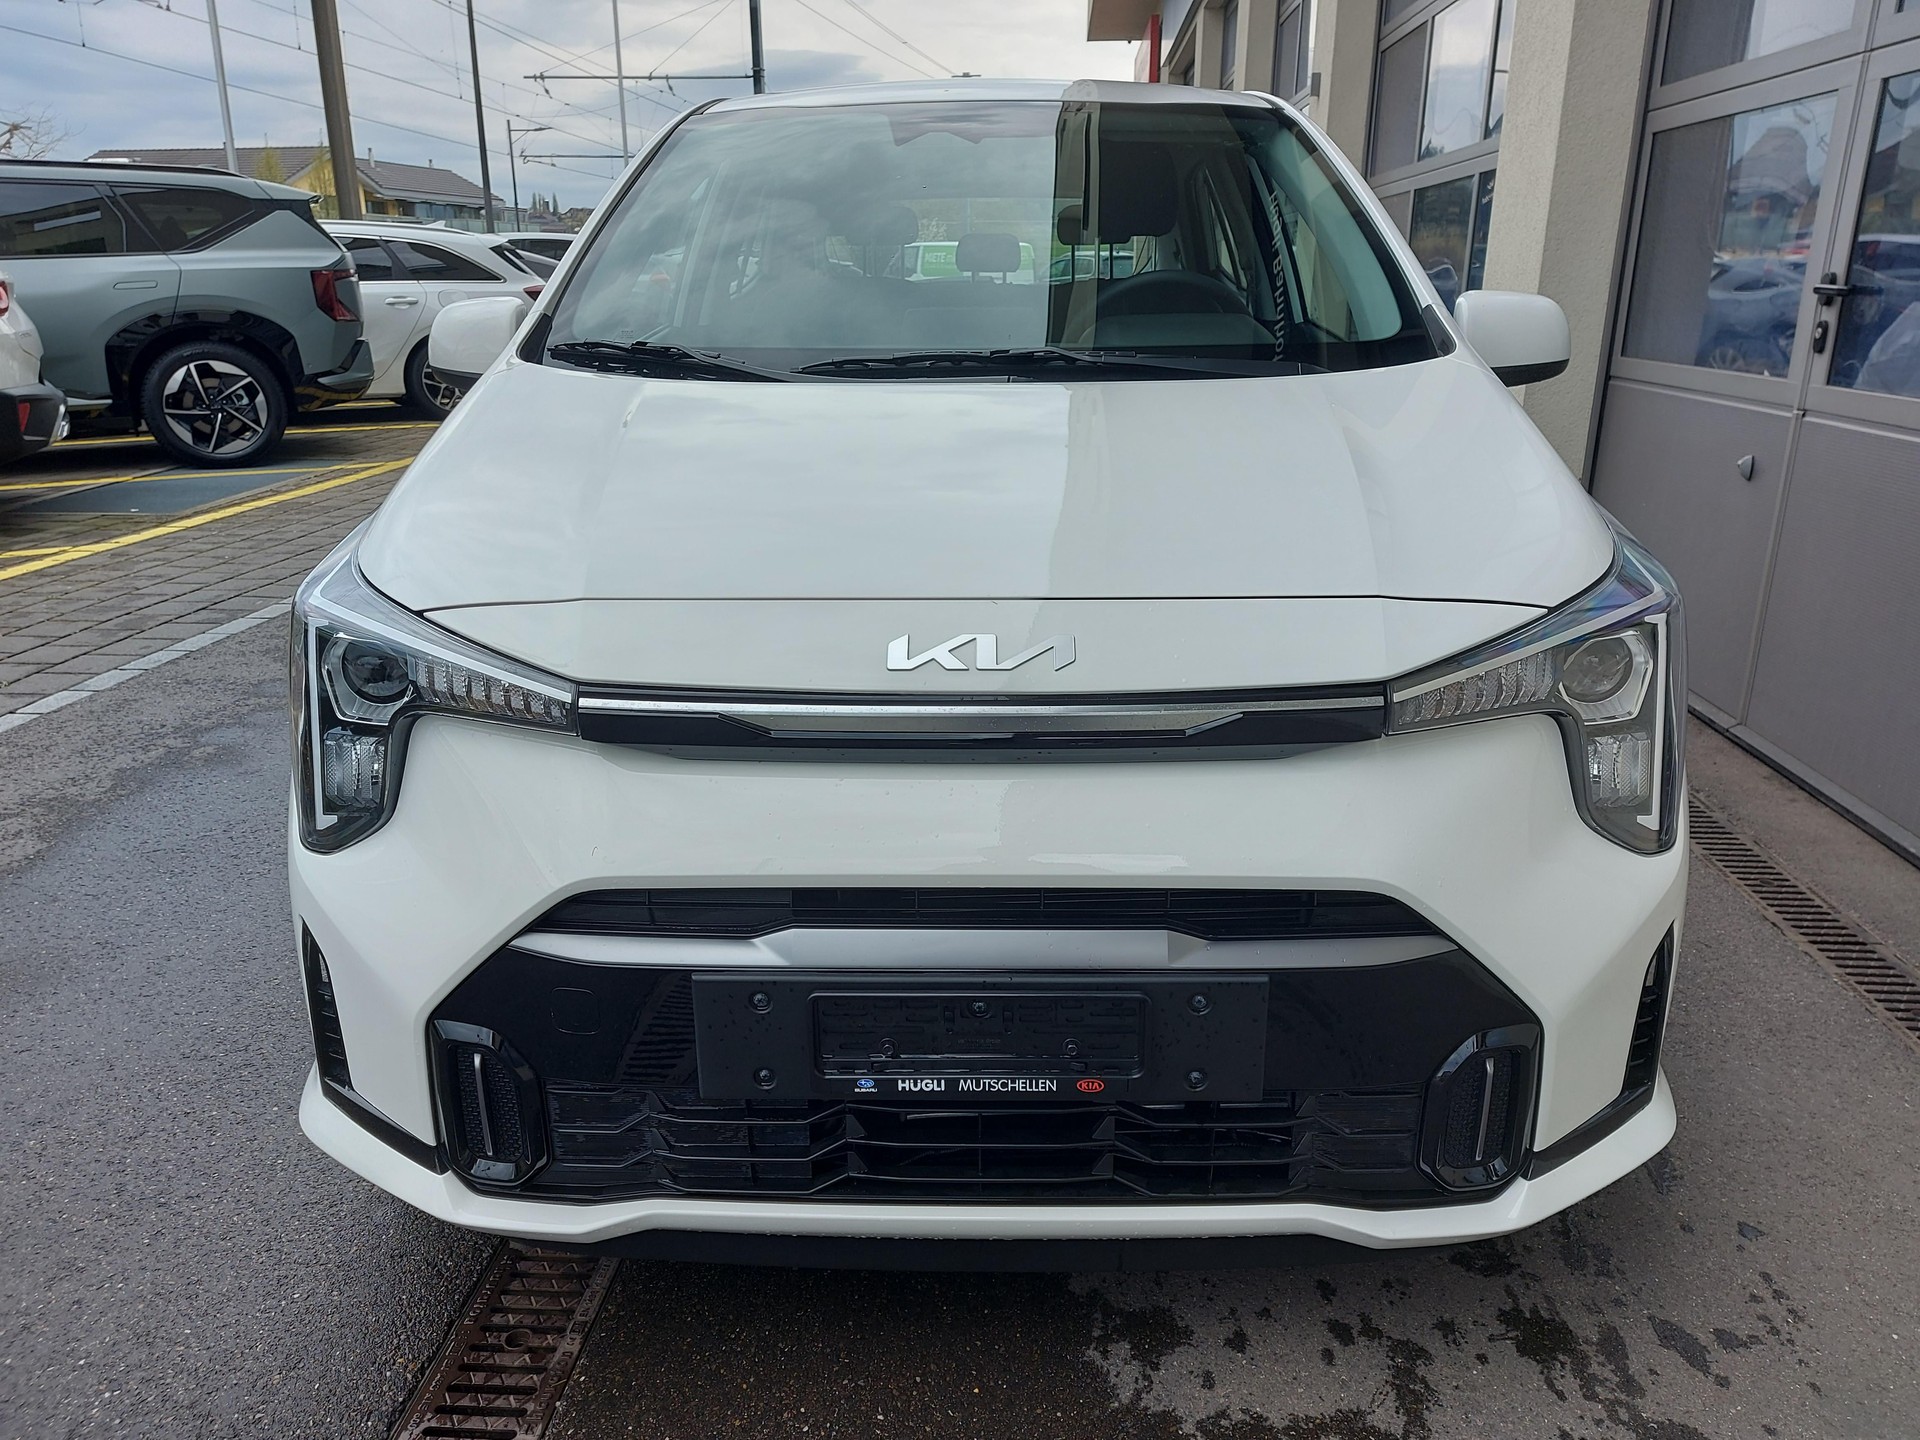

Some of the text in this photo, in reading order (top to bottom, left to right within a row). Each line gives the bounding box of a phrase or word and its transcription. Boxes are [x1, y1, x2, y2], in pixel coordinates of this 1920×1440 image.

[886, 633, 1076, 672] KIA
[898, 1078, 1057, 1092] HÜGLI MUTSCHELLEN
